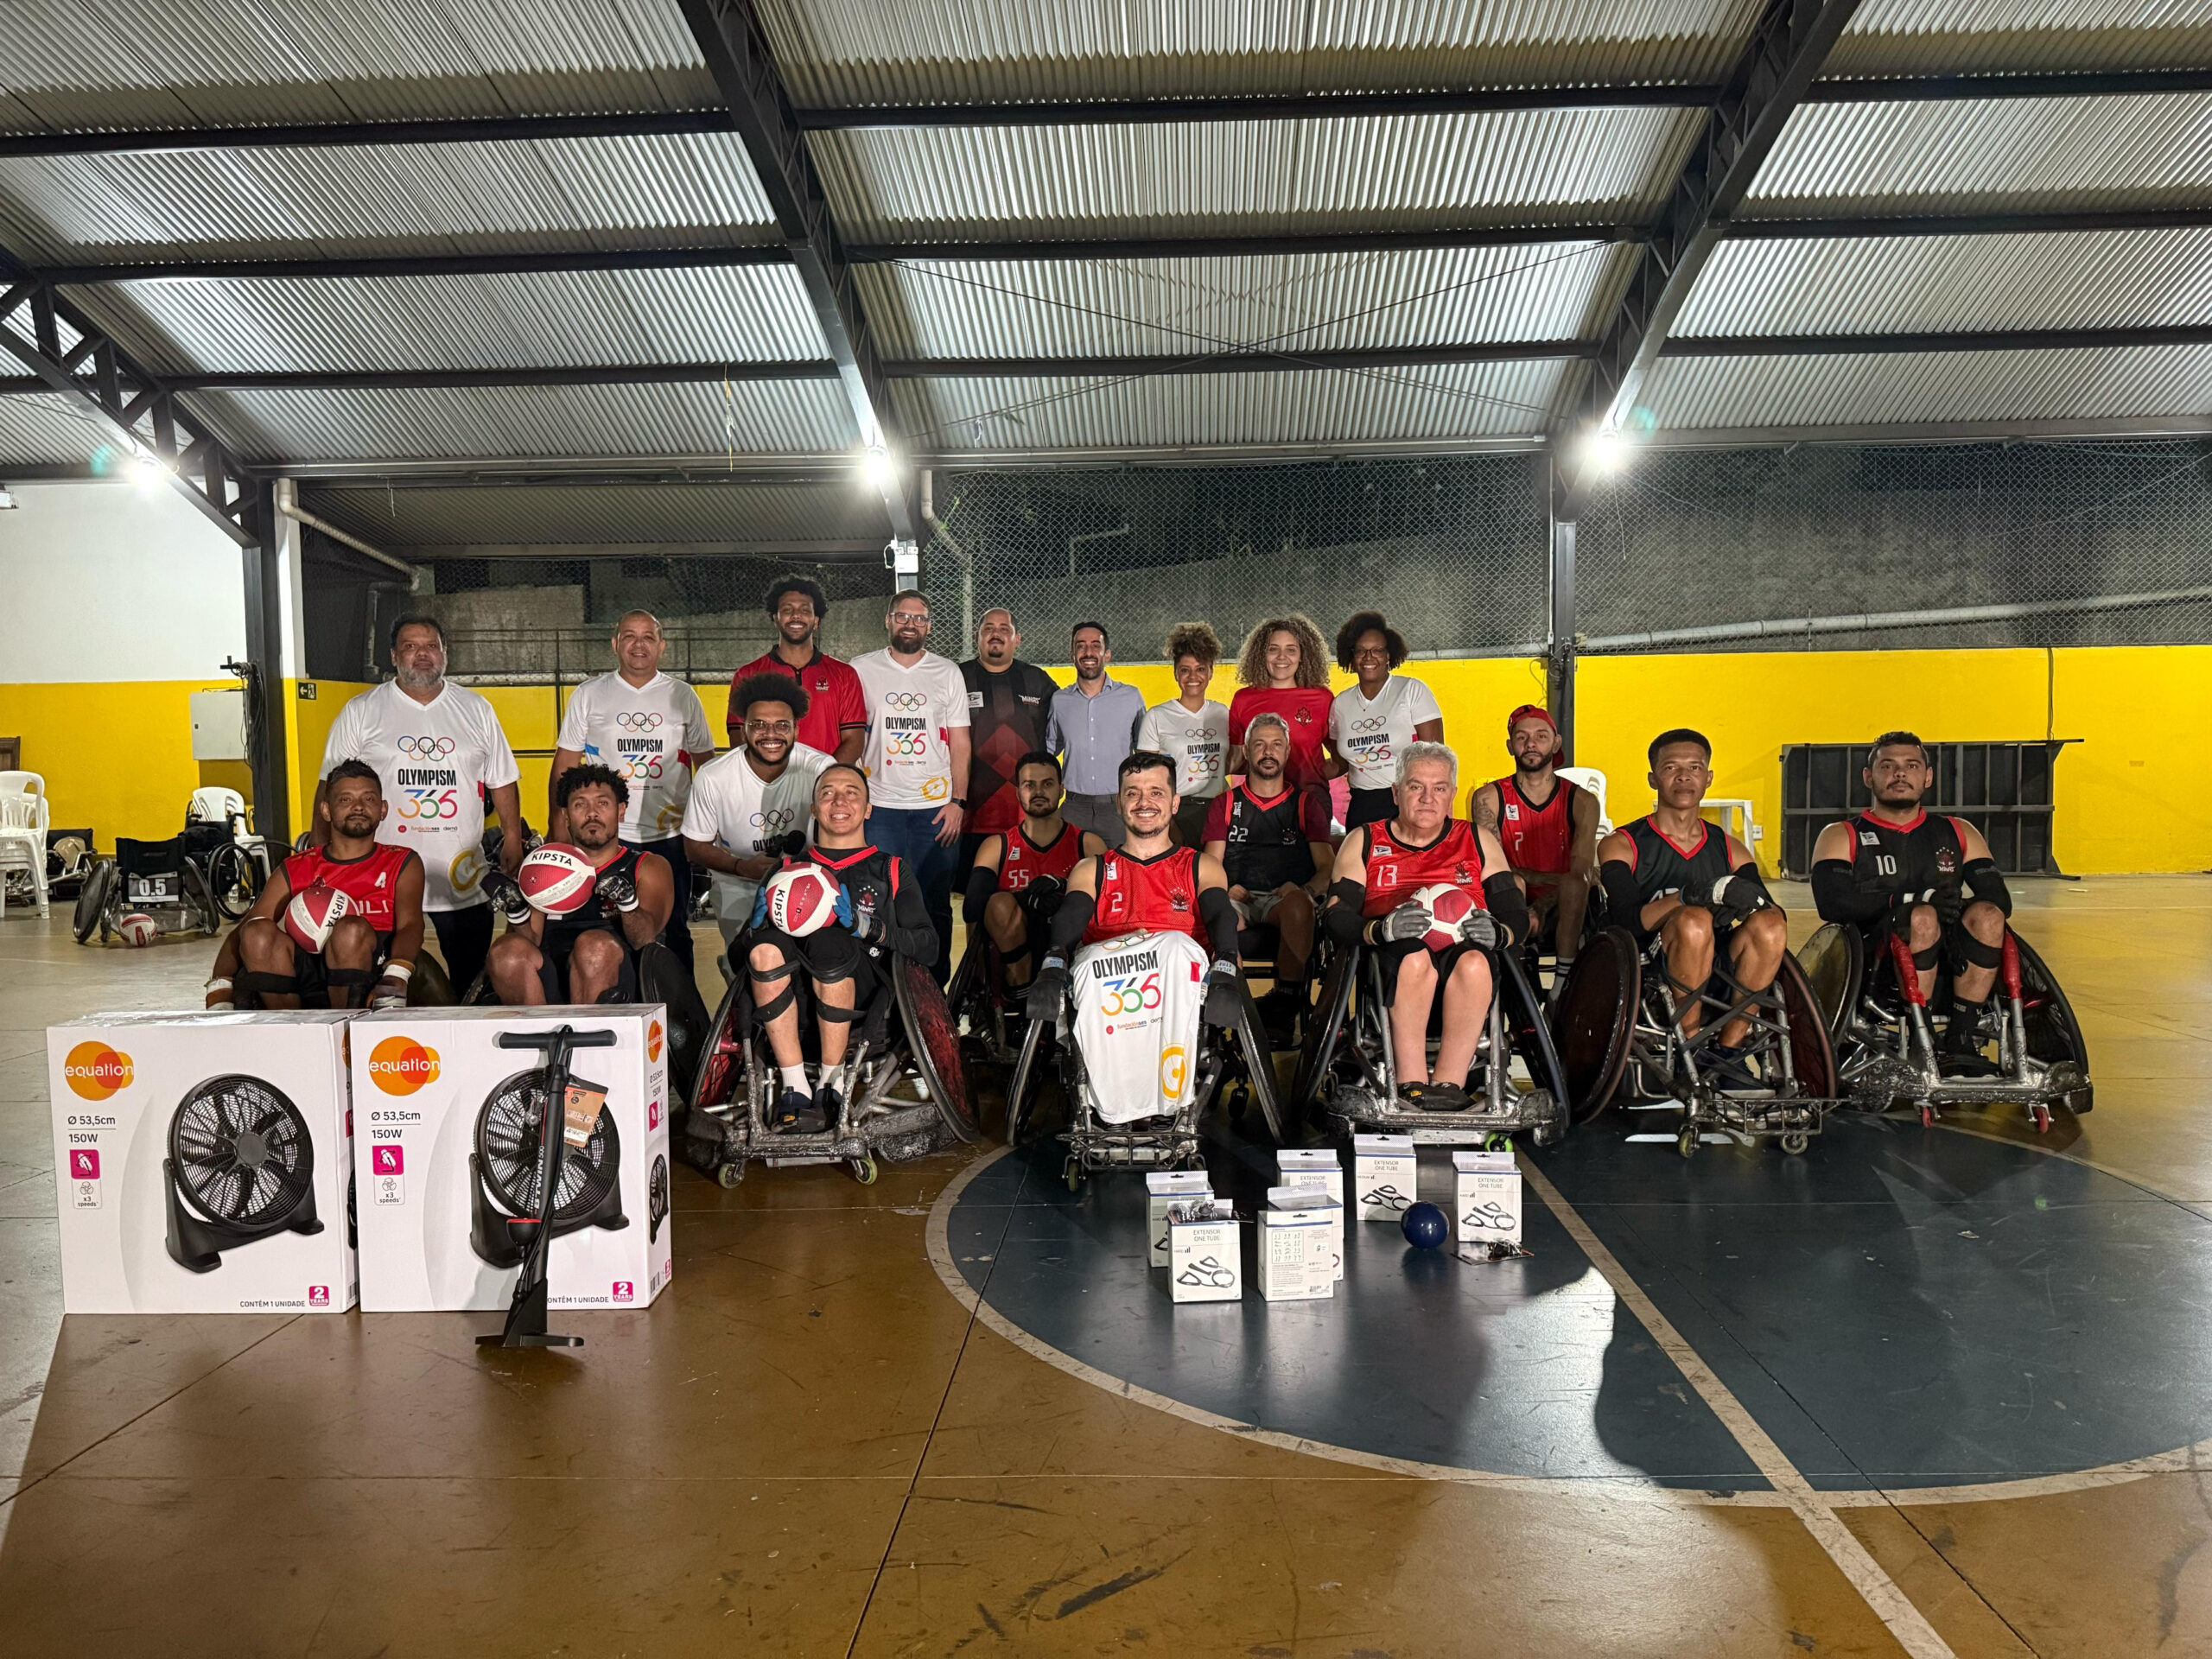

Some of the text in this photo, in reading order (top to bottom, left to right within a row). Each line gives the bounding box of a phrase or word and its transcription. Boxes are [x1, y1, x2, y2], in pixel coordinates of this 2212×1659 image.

[886, 716, 926, 730] OLYMPISM
[617, 739, 663, 753] OLYMPISM
[886, 732, 926, 755] 365
[1187, 743, 1220, 754] OLYMPISM
[1348, 733, 1389, 747] OLYMPISM
[1188, 754, 1219, 773] 365
[1353, 745, 1391, 765] 365
[618, 754, 663, 779] 365
[397, 768, 457, 785] OLYMPISM
[397, 789, 458, 819] 365
[1228, 825, 1249, 842] 22
[1514, 831, 1523, 851] 7
[531, 852, 572, 867] KIPSTA
[1875, 855, 1897, 876] 10
[374, 871, 386, 888] 4
[1008, 869, 1029, 888] 55
[1377, 864, 1398, 887] 13
[139, 878, 167, 896] 0.5
[326, 894, 346, 927] KIPSTA
[359, 899, 389, 914] ILI
[773, 889, 785, 928] KIPSTA
[1111, 892, 1122, 912] 2
[1092, 950, 1158, 979] OLYMPISM
[1101, 973, 1161, 1016] 365
[65, 1063, 133, 1078] equation
[369, 1058, 440, 1074] equation
[79, 1116, 116, 1126] 53,5cm
[384, 1111, 421, 1122] 53,5cm
[69, 1134, 98, 1143] 150W
[372, 1129, 402, 1139] 150W
[314, 1287, 325, 1299] 2
[618, 1283, 628, 1294] 2
